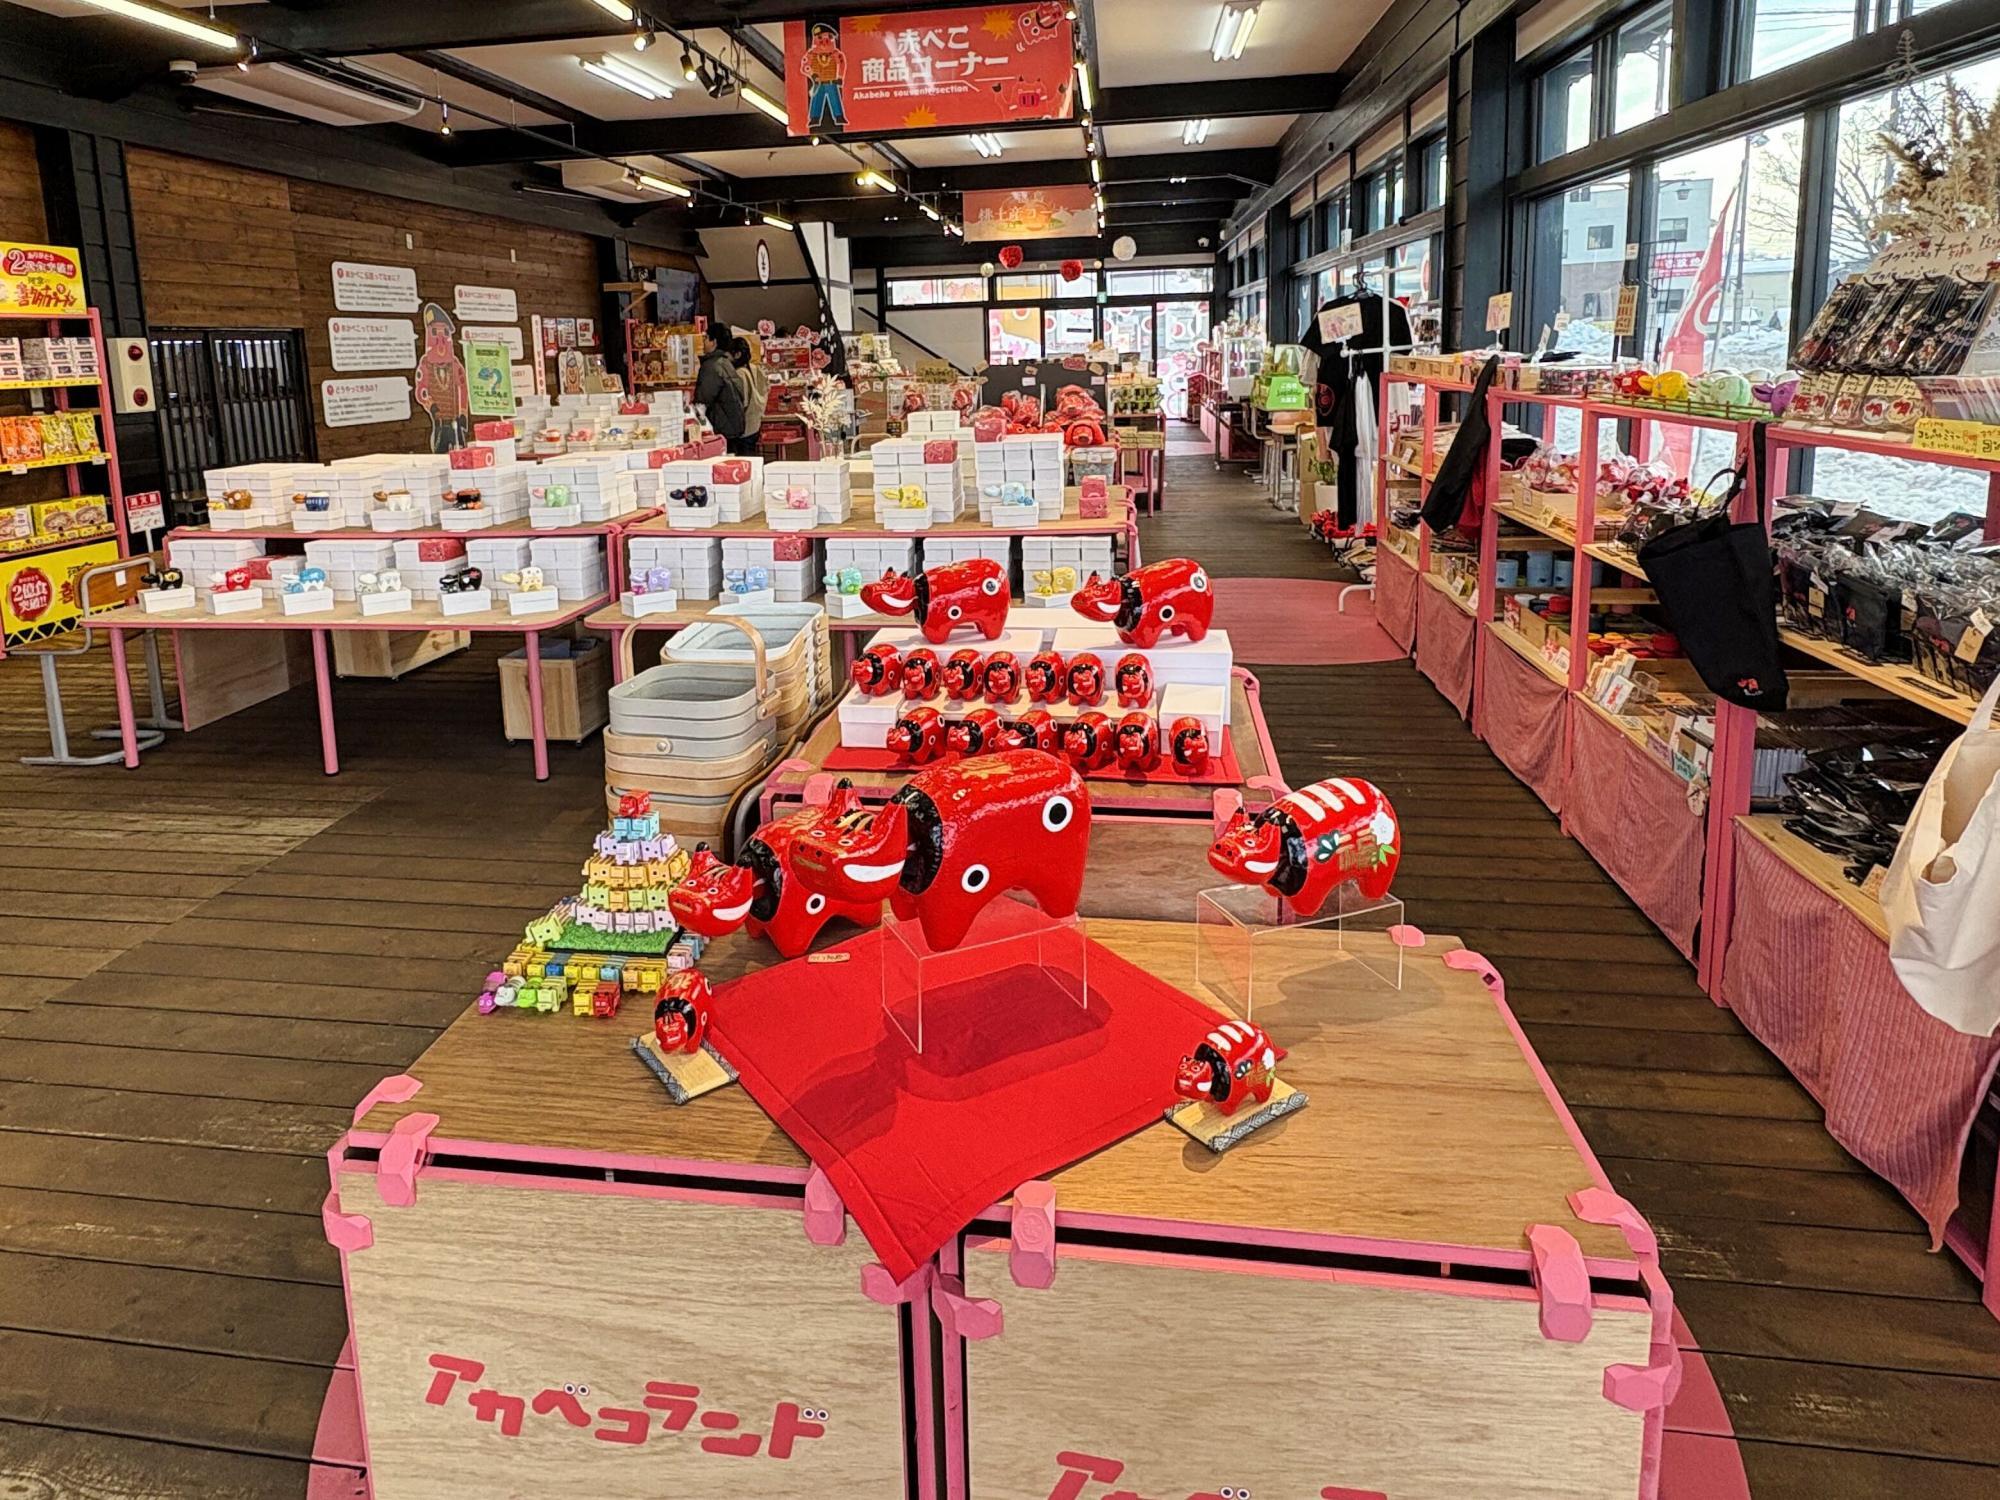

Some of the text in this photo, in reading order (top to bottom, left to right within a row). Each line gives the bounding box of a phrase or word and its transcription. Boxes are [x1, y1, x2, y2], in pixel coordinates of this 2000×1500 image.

[897, 25, 970, 55] 赤べこ
[861, 51, 1009, 84] 商品コーナー
[853, 90, 890, 100] Akabeko
[935, 85, 969, 95] section
[425, 1353, 830, 1459] アカベコランド
